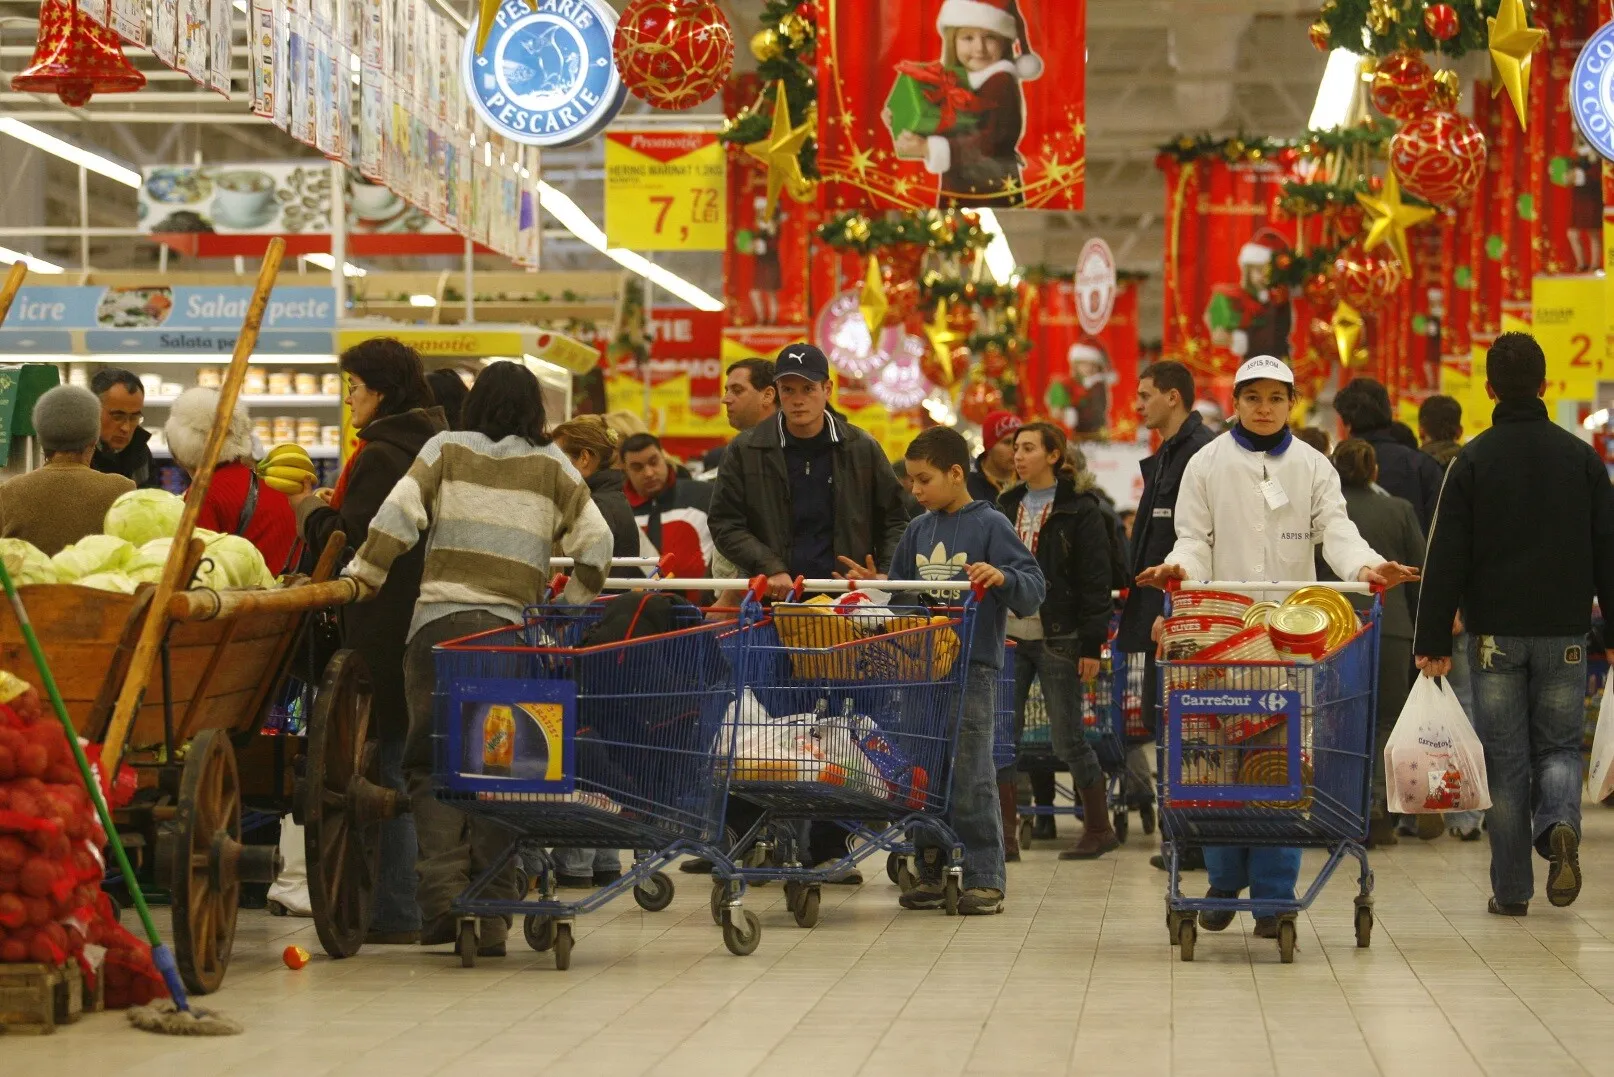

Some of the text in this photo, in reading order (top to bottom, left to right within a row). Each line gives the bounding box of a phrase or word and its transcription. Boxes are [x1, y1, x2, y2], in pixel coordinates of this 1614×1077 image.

[493, 0, 594, 29] PESARIE
[19, 296, 66, 321] icre
[186, 294, 249, 319] Salat
[159, 333, 213, 348] Salata
[1247, 360, 1263, 370] ASPIS
[1171, 621, 1201, 632] OLIVES
[1180, 694, 1252, 706] Carrefour
